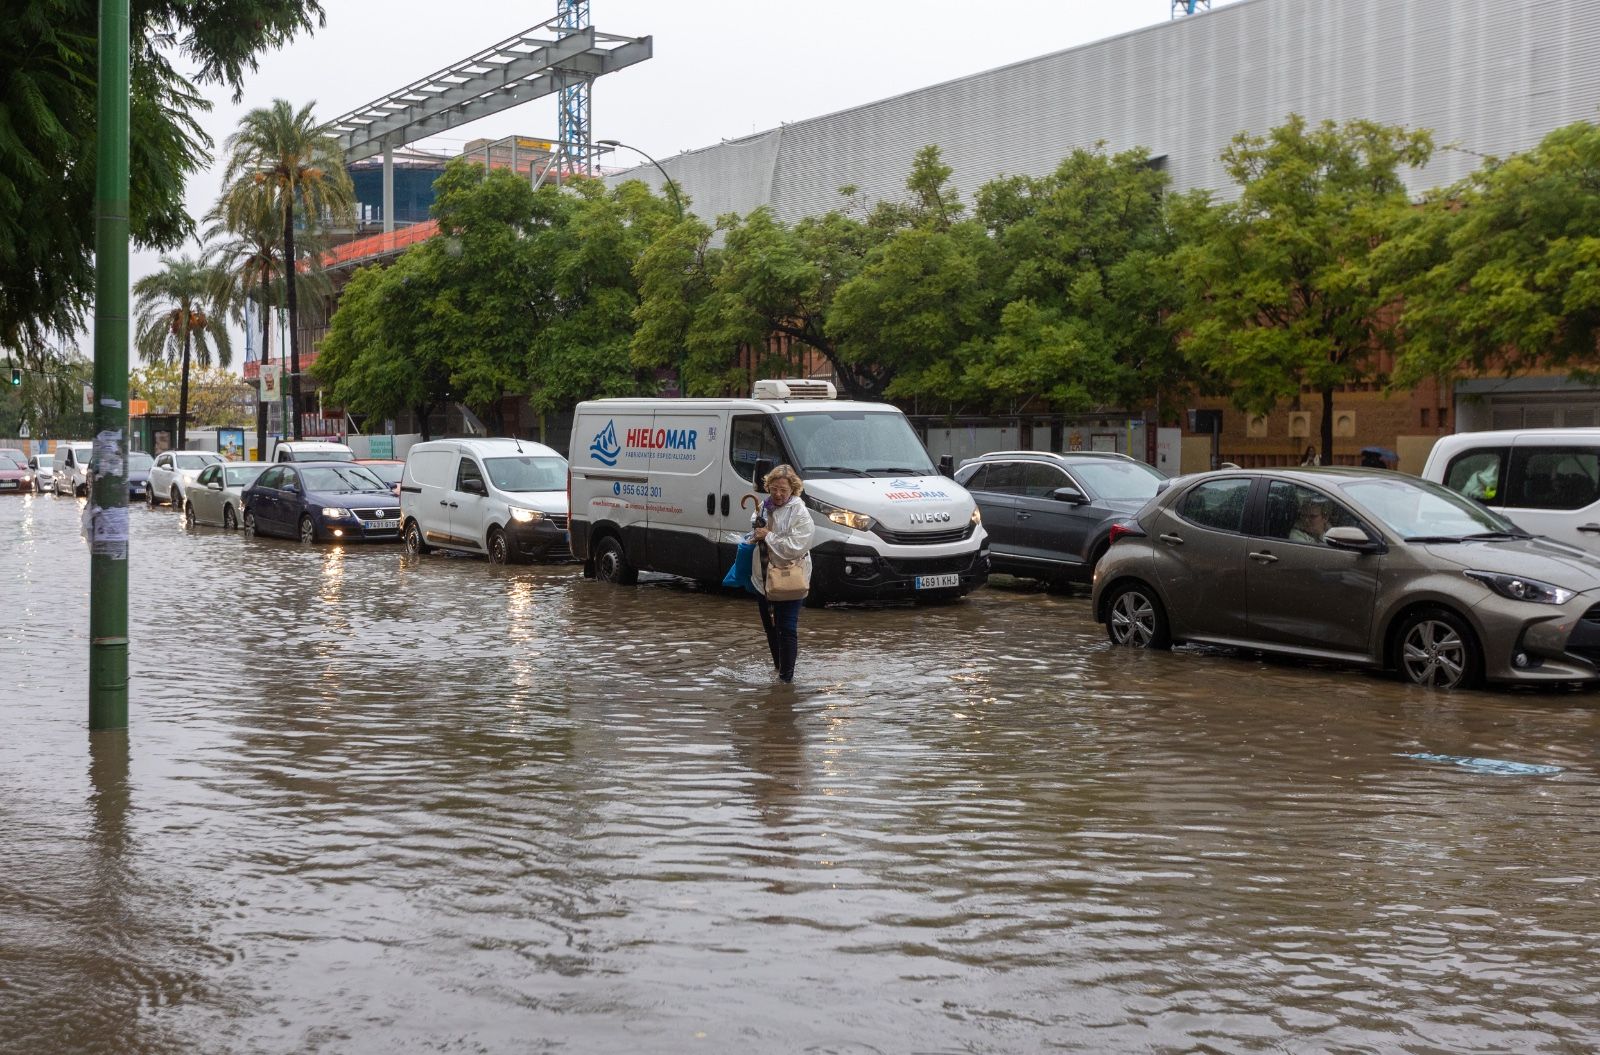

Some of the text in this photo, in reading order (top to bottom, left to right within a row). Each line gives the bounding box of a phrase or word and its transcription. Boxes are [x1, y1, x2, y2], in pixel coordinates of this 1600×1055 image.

[626, 428, 697, 450] HIELOMAR
[622, 484, 662, 498] 955 632 301
[885, 491, 948, 500] HIELOMAR
[910, 512, 950, 524] IVECO
[922, 576, 957, 587] 4691 KHJ
